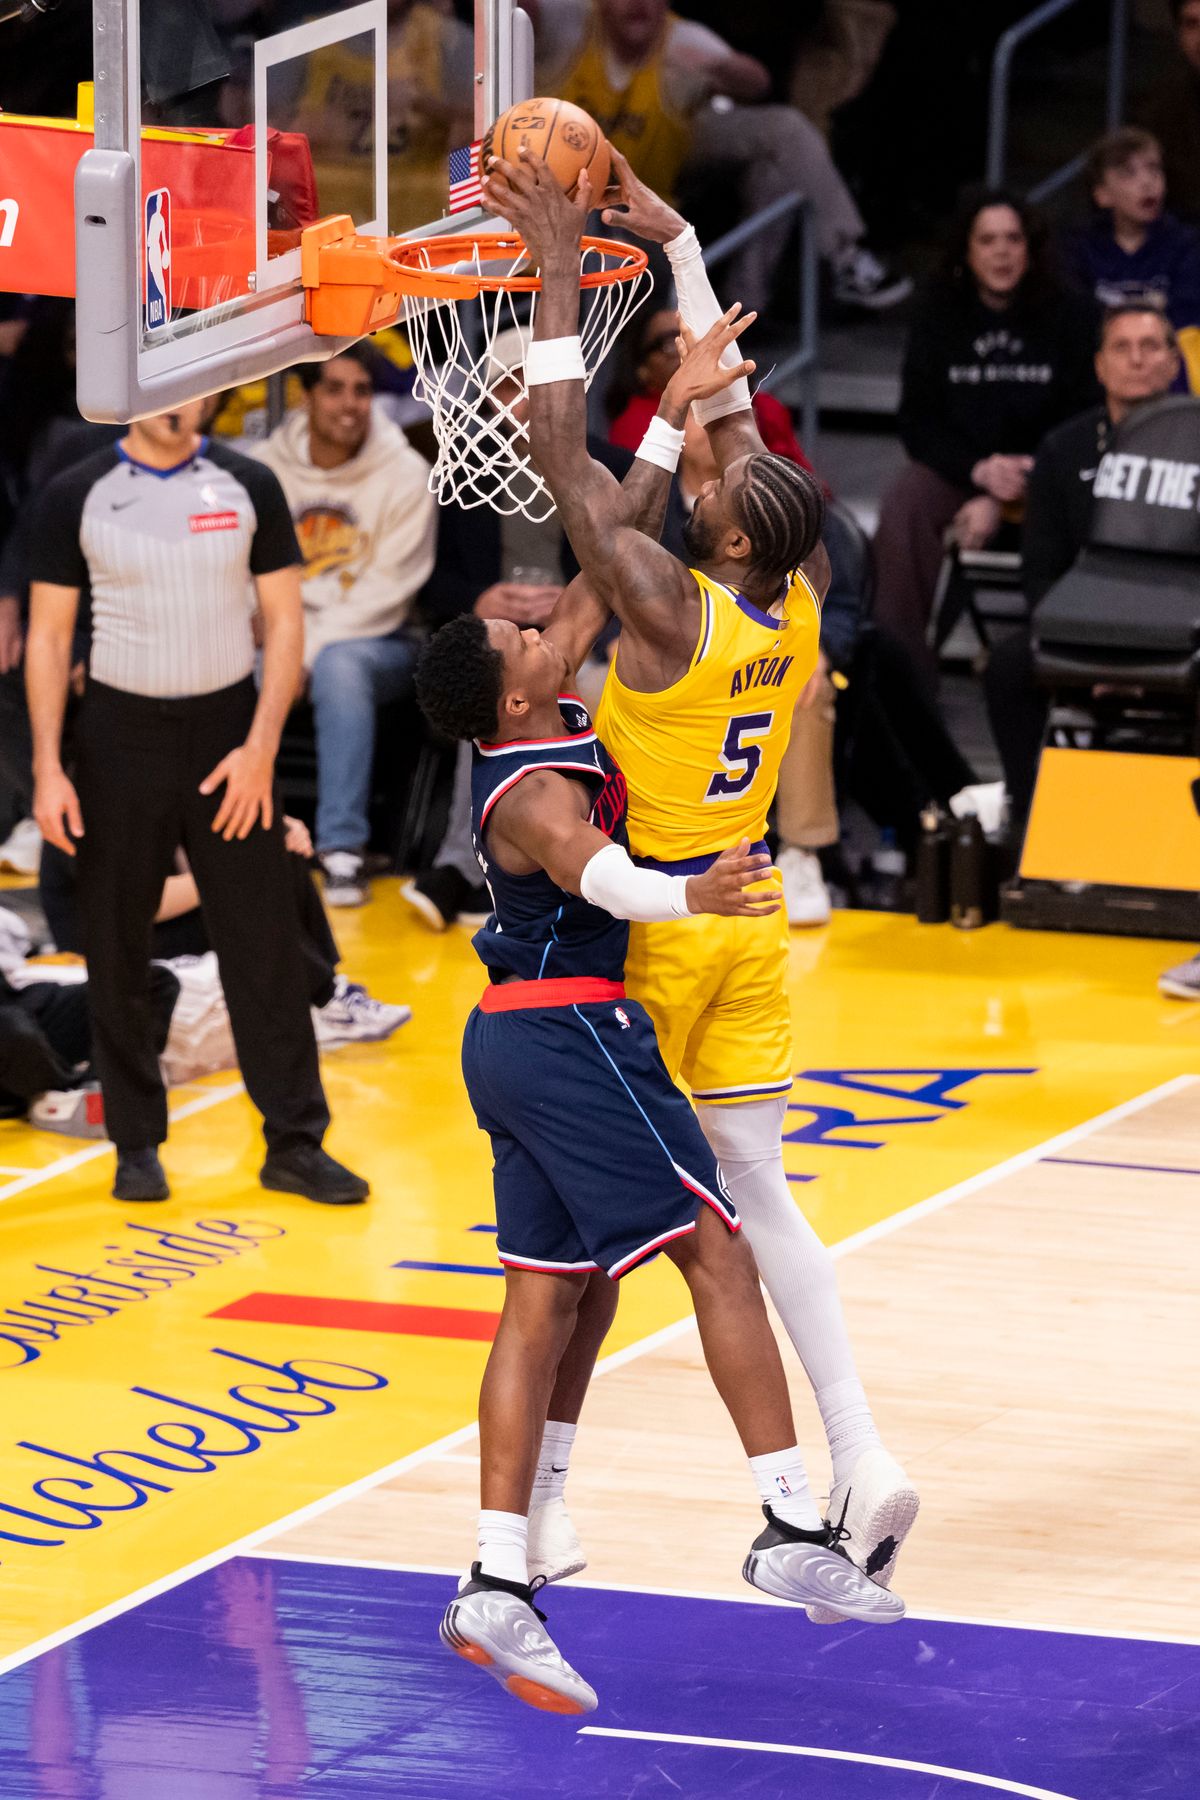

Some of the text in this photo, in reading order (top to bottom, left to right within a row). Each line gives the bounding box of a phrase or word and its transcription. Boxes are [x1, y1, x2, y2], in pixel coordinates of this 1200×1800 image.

[1092, 452, 1148, 501] GET
[1145, 458, 1200, 510] THE
[730, 655, 796, 699] AYTON
[702, 710, 775, 803] 5
